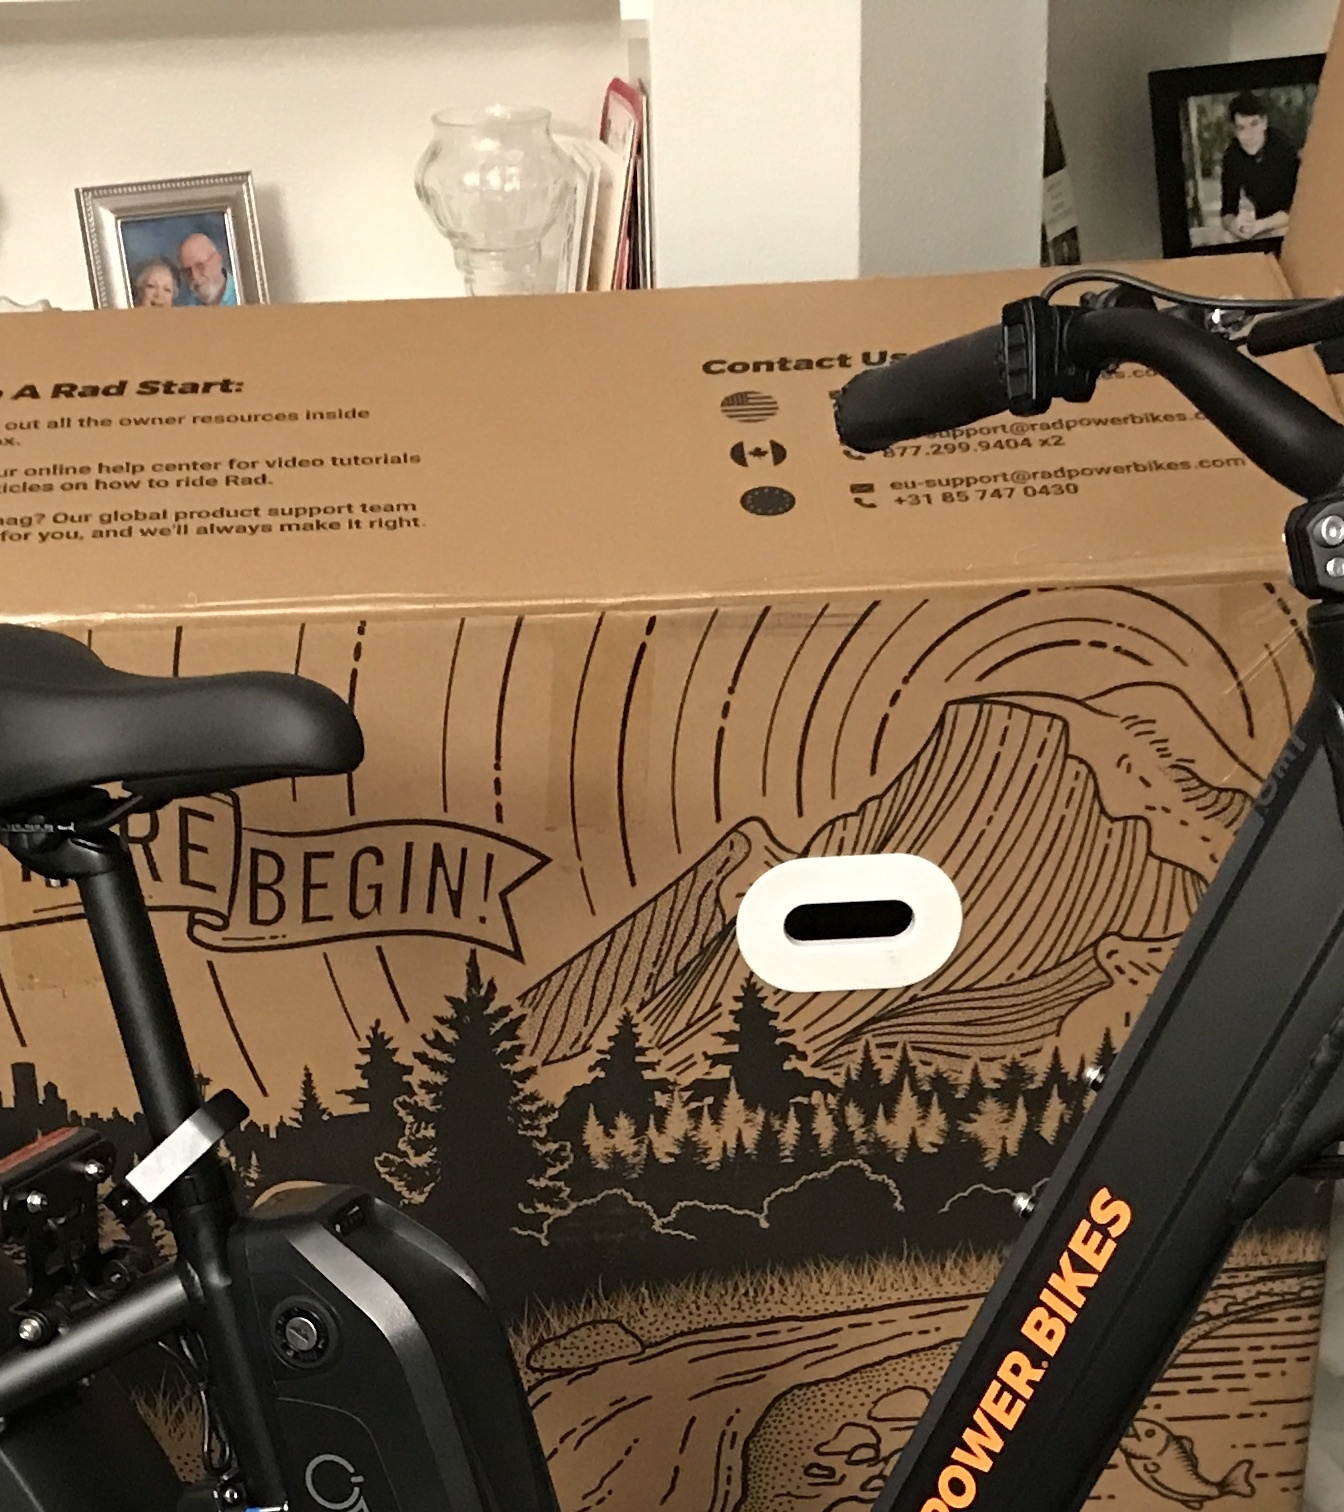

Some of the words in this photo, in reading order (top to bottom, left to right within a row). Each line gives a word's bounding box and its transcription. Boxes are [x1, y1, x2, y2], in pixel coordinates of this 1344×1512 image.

[702, 353, 852, 375] Contact
[10, 384, 40, 400] A
[51, 380, 128, 399] Rad
[136, 378, 244, 396] Start:
[5, 418, 40, 431] out
[47, 417, 72, 430] all
[78, 416, 112, 428] the
[119, 415, 186, 427] owner
[192, 411, 299, 424] resources
[306, 407, 370, 420] inside
[1039, 434, 1066, 447] x2
[24, 463, 91, 477] online
[98, 461, 145, 476] help
[151, 459, 222, 473] center
[228, 457, 260, 471] for
[265, 455, 324, 470] video
[331, 451, 421, 467] tutorials
[890, 456, 1246, 490] eu-support@radpowerbikes.com
[60, 480, 89, 492] on
[95, 478, 141, 492] how
[147, 476, 170, 489] to
[176, 474, 218, 488] ride
[224, 472, 274, 488] Rad.
[895, 493, 933, 506] +31
[941, 490, 969, 504] 85
[975, 487, 1015, 501] 747
[1023, 482, 1078, 498] 0430
[52, 510, 92, 525] Our
[99, 508, 168, 526] global
[174, 505, 261, 523] product
[267, 502, 354, 519] support
[360, 501, 417, 514] team
[0, 528, 32, 542] for
[38, 528, 85, 544] you,
[91, 524, 133, 539] and
[139, 522, 188, 538] we'll
[195, 520, 273, 537] always
[279, 518, 341, 533] make
[348, 517, 362, 530] it
[369, 515, 427, 532] right.
[249, 840, 495, 927] BEGIN!
[1019, 1186, 1134, 1358] BIKES
